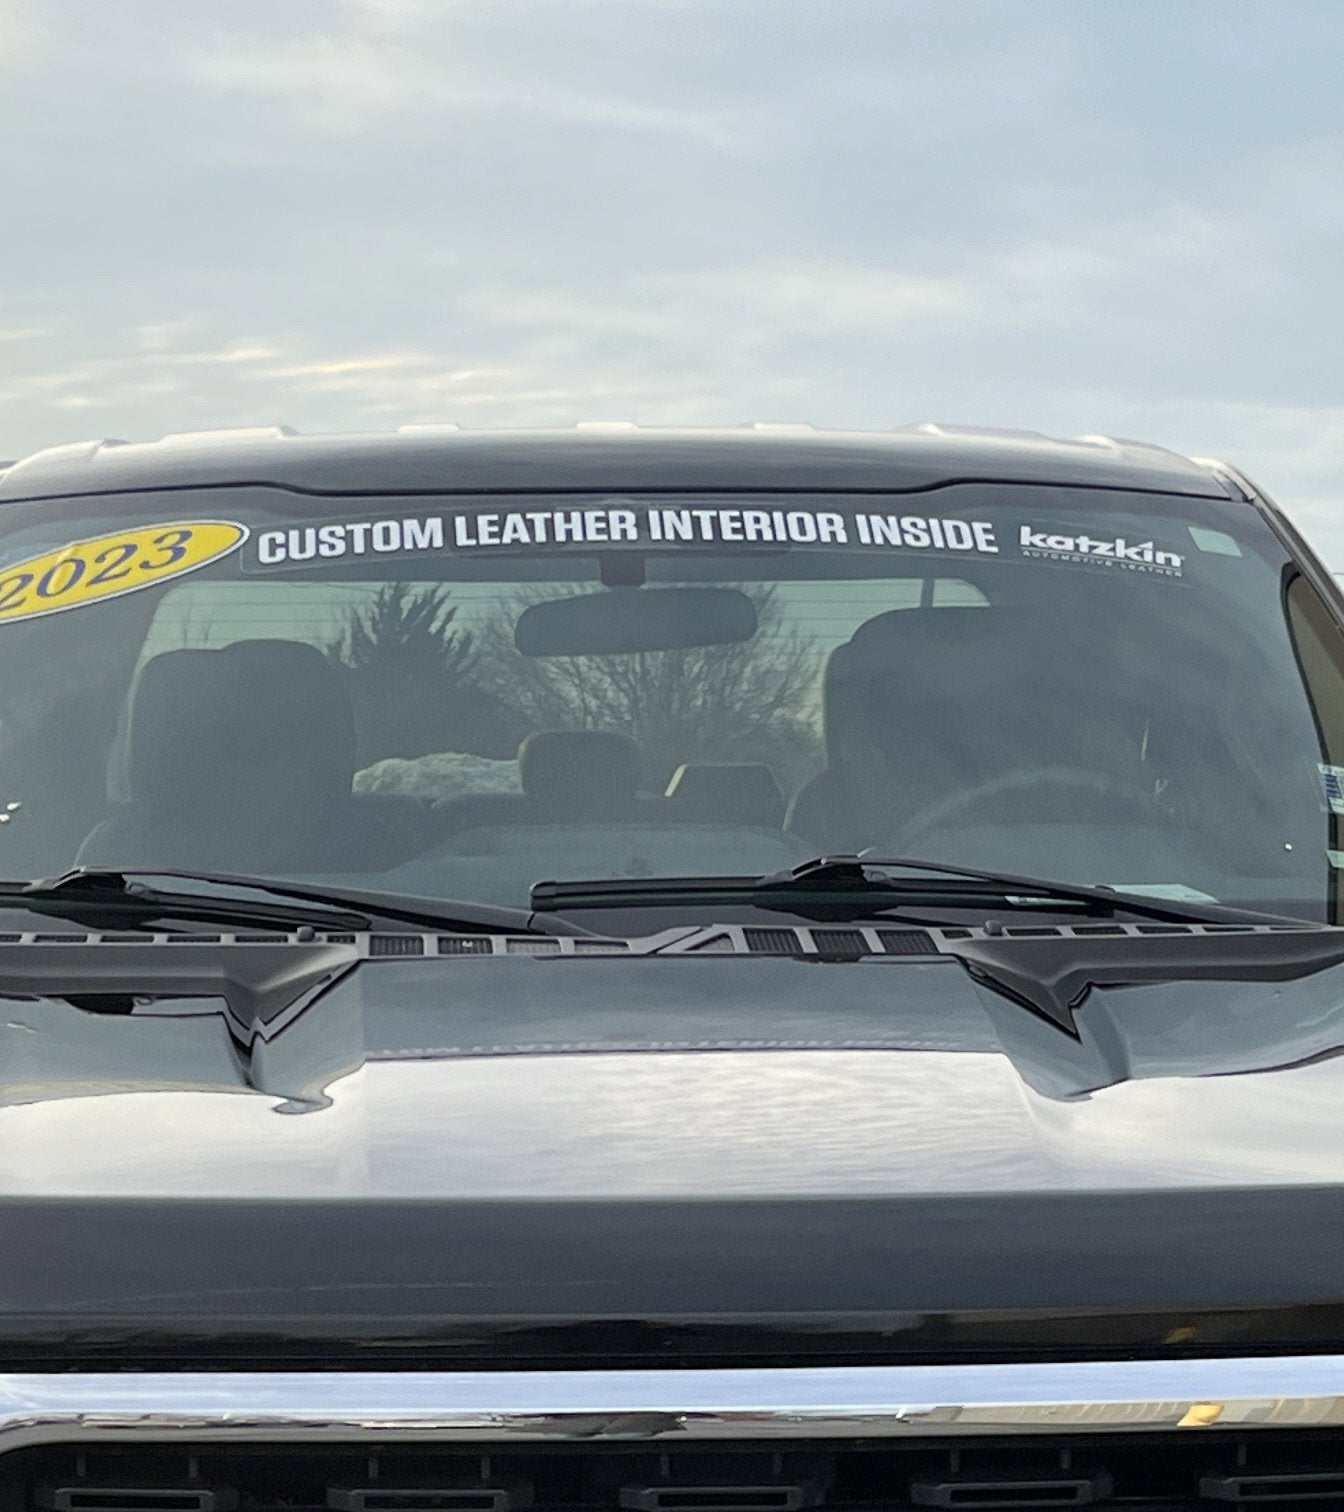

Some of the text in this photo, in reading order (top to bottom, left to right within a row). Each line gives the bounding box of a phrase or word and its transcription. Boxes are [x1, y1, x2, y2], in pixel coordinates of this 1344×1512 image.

[258, 509, 999, 565] CUSTOM LEATHER INTERIOR INSIDE
[1020, 525, 1182, 567] katzkin
